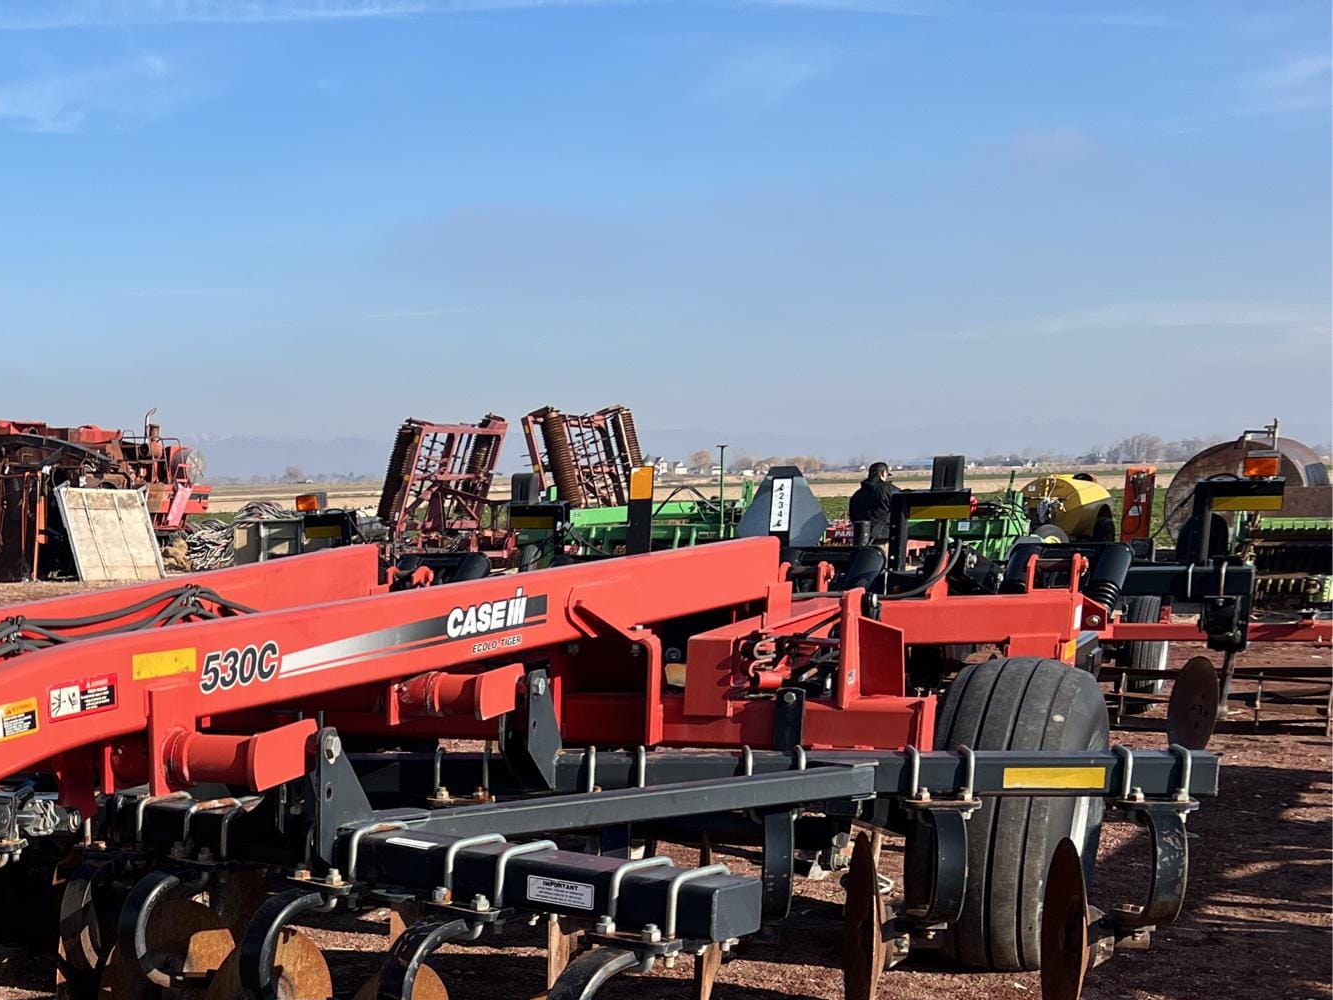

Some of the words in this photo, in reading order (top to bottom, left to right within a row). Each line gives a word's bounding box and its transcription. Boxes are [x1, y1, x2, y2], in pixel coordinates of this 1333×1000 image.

[446, 600, 507, 638] CASE
[200, 641, 278, 694] 530C
[542, 880, 578, 891] IMPORTANT
